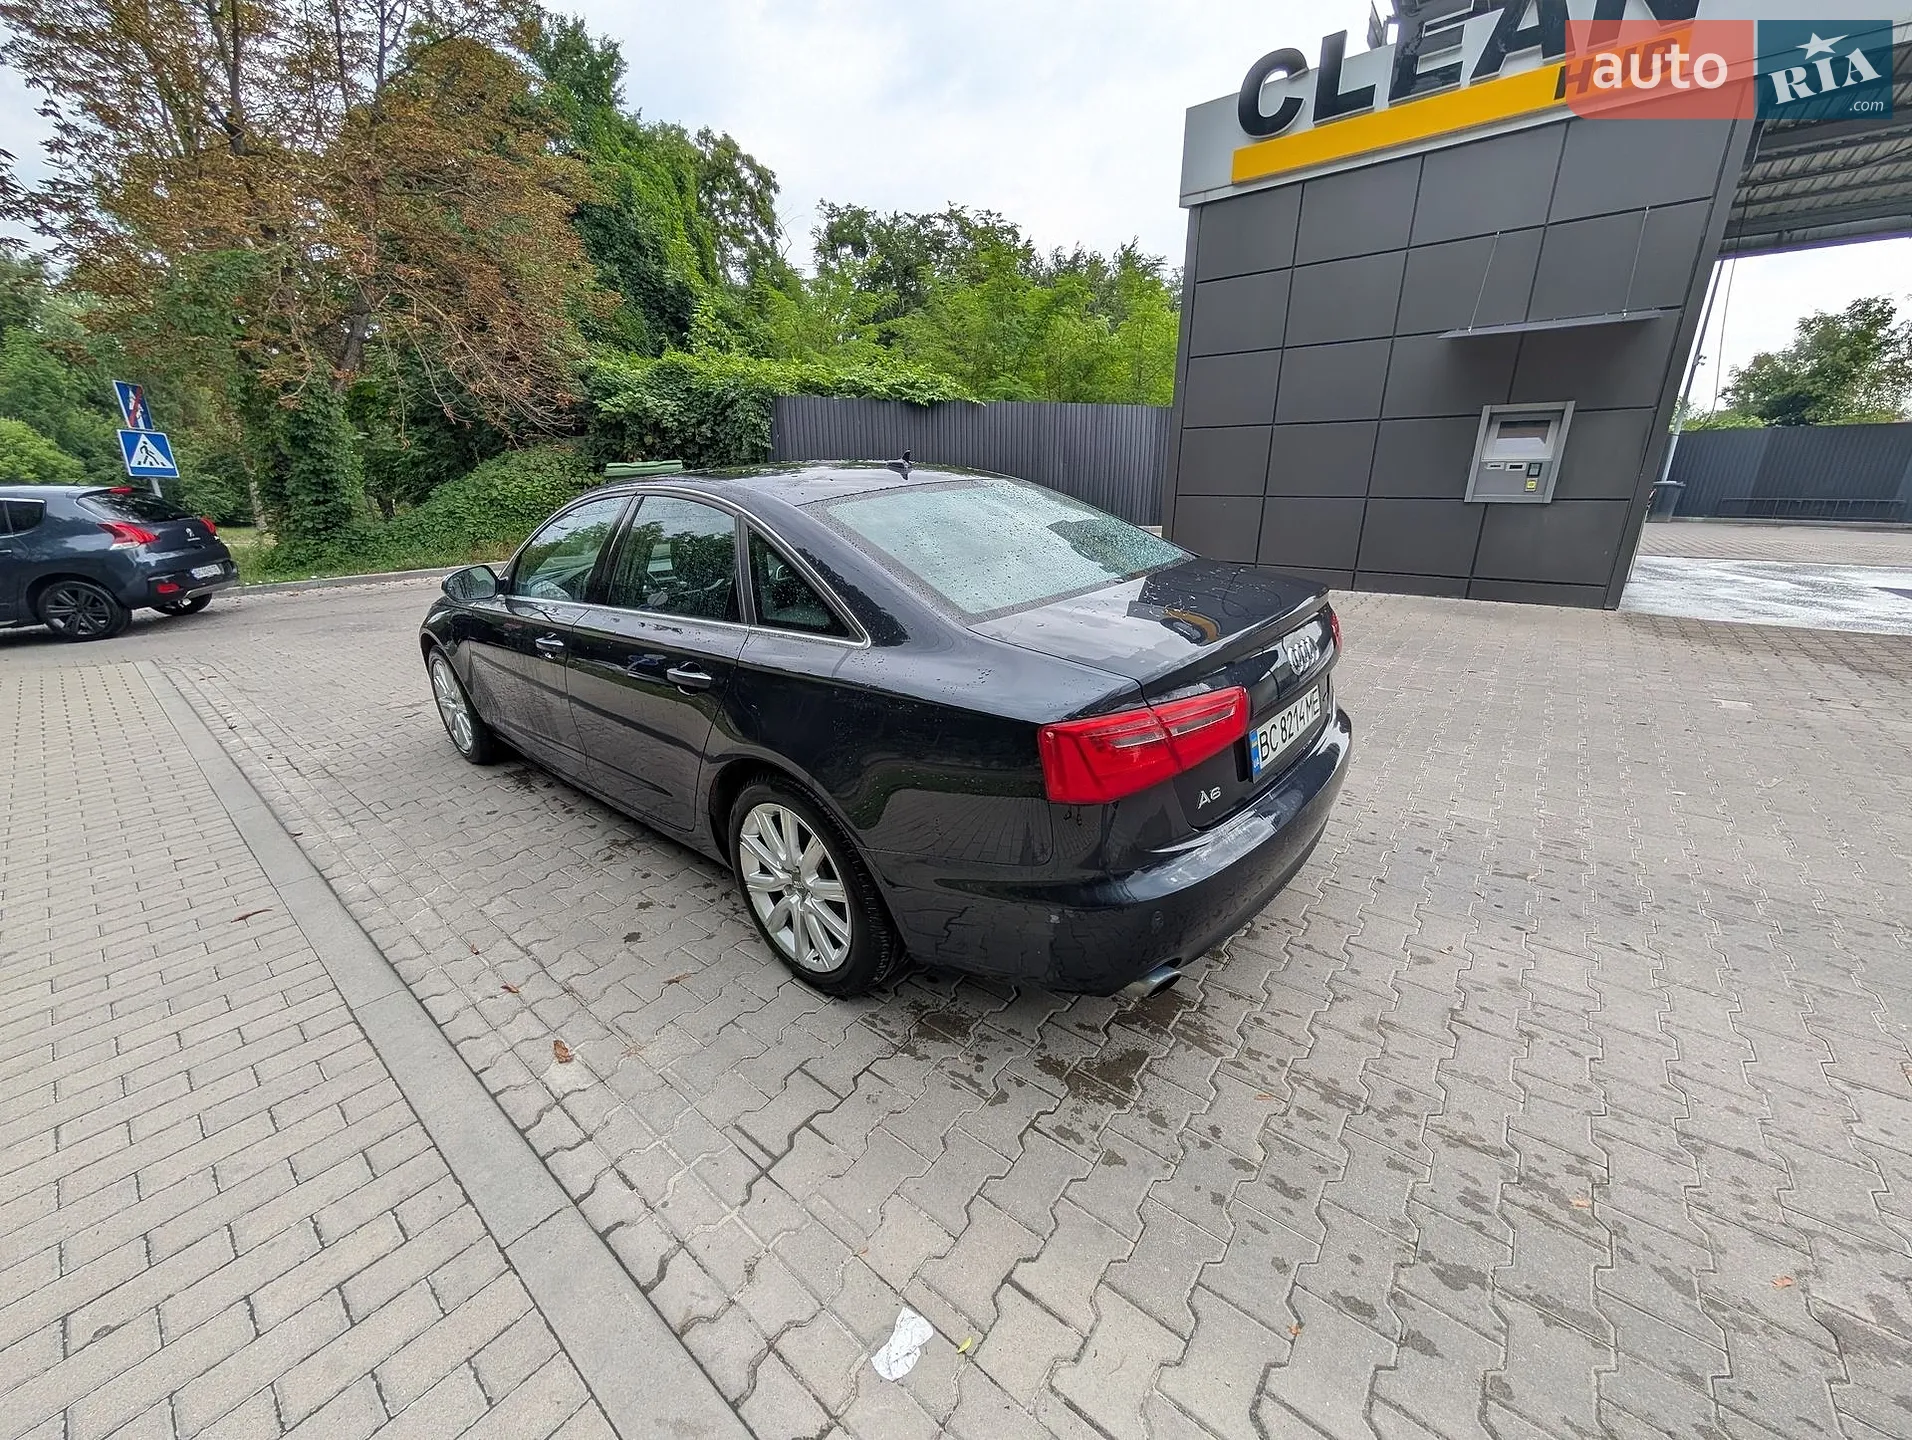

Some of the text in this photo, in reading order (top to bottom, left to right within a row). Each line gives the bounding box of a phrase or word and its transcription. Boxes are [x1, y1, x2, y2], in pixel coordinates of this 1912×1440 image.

[1259, 723, 1279, 762] BC
[1280, 699, 1306, 744] 8214
[1197, 786, 1221, 810] A6
